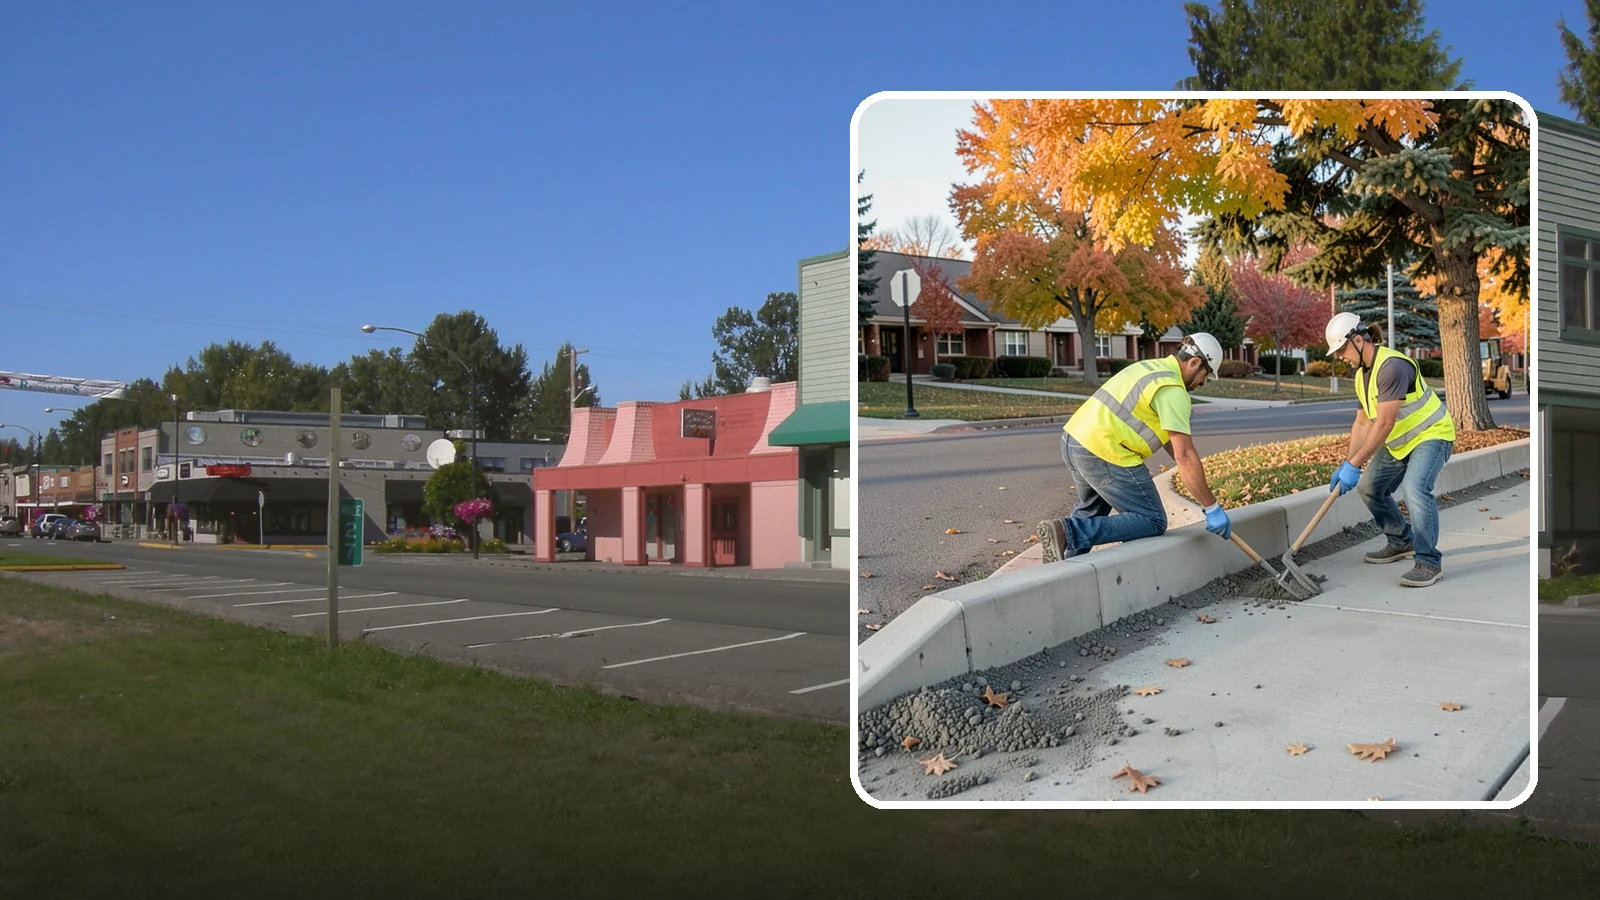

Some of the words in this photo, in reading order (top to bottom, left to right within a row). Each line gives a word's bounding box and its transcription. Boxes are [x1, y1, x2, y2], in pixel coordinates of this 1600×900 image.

[19, 379, 57, 392] Railroad
[341, 505, 361, 517] MILE
[345, 522, 356, 538] 2
[344, 543, 356, 560] 7
